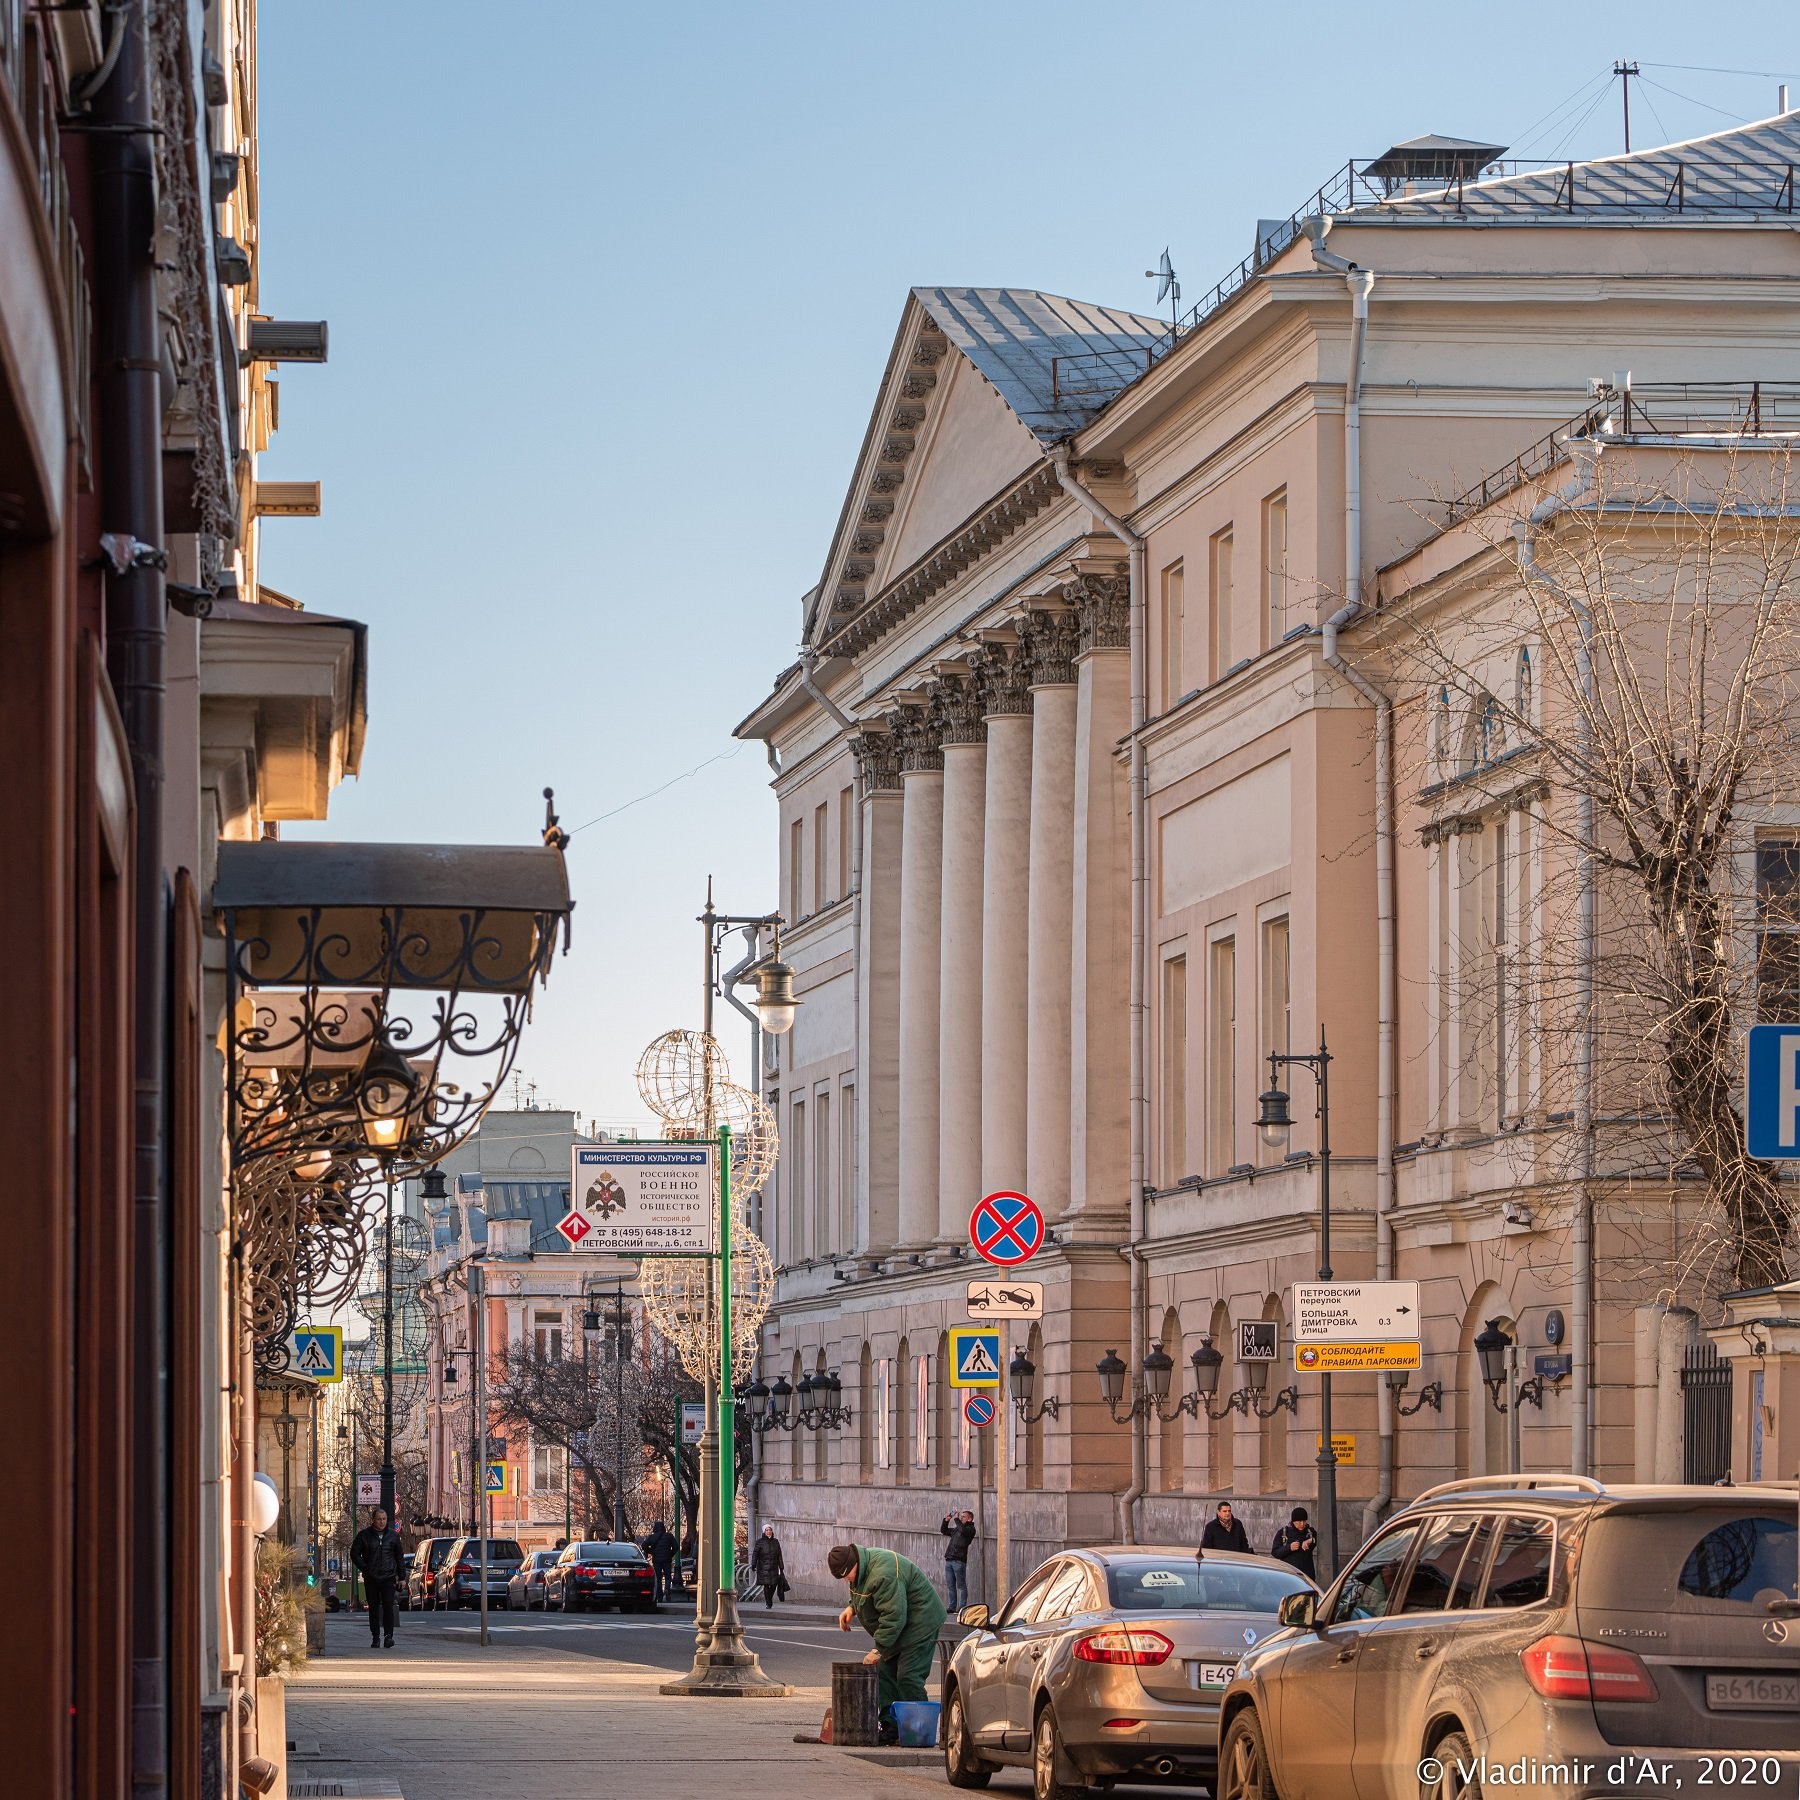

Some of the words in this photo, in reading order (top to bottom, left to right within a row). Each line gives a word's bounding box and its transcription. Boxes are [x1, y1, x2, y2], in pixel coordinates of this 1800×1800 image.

[584, 1154, 645, 1162] МИНИСТЕРСТВО
[647, 1154, 688, 1162] КУЛЬТУРЫ
[690, 1154, 702, 1162] РФ
[640, 1170, 700, 1178] РОССИЙСКОЕ
[640, 1181, 698, 1190] ВОЕННО
[640, 1203, 700, 1211] ОБЩЕСТВО
[651, 1215, 691, 1223] история.рф
[611, 1229, 617, 1237] 8
[620, 1229, 644, 1238] (495)
[646, 1229, 692, 1237] 648-18-12
[582, 1237, 643, 1247] ПЕТРОВСКИЙ
[698, 1239, 704, 1247] 1
[1300, 1288, 1361, 1297] ПЕТРОВСКИЙ
[1300, 1298, 1341, 1306] переулок
[1301, 1310, 1349, 1318] БОЛЬШАЯ
[1301, 1318, 1358, 1327] ДМИТРОВКА
[1244, 1326, 1255, 1336] M
[1244, 1336, 1255, 1346] M
[1244, 1346, 1273, 1356] OMA
[1321, 1346, 1386, 1355] СОБЛЮДАЙТЕ
[1366, 1357, 1418, 1366] ПАРКОВКИ!
[1600, 1628, 1627, 1636] GLS
